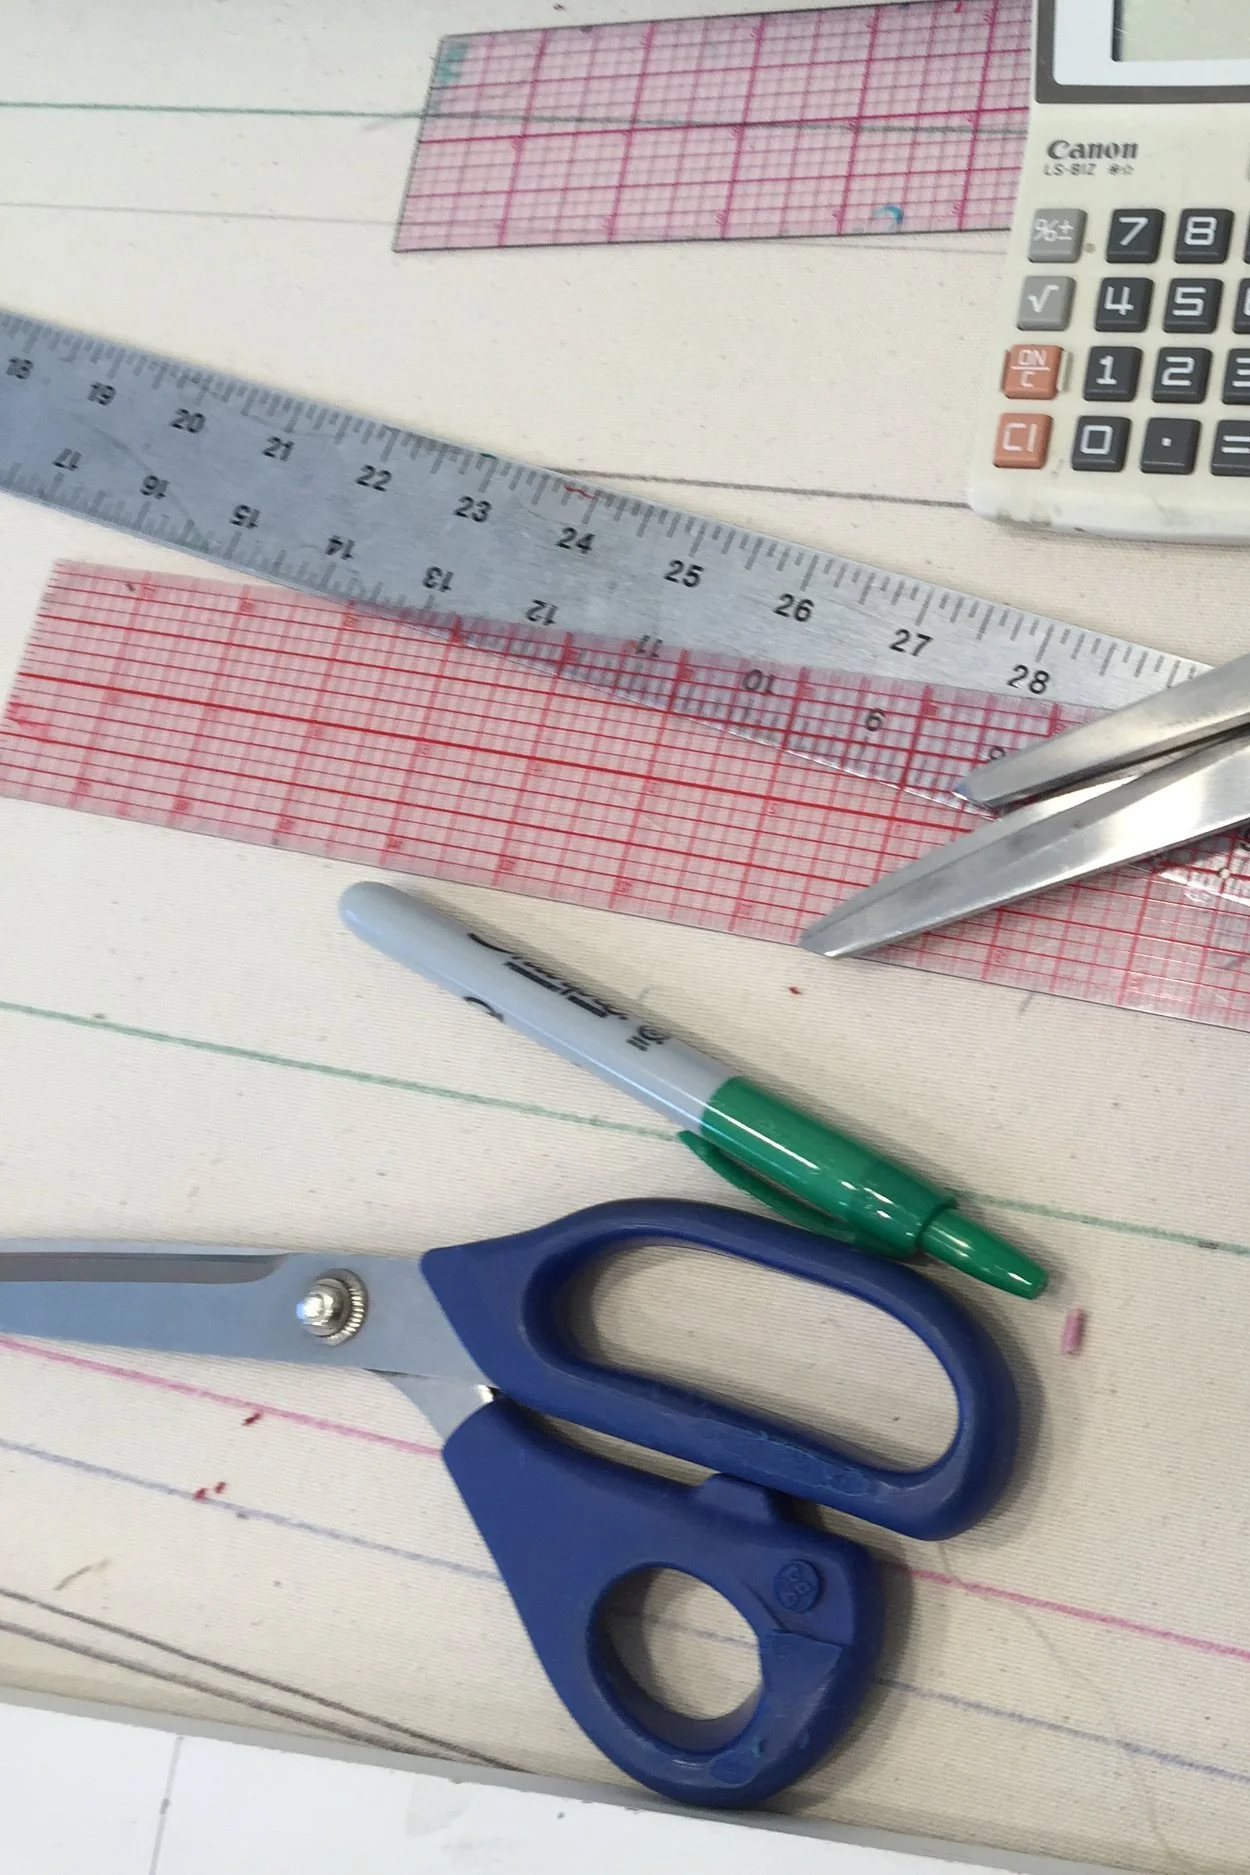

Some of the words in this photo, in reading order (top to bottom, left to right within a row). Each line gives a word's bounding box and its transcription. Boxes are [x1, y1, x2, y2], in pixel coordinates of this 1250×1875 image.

[1047, 139, 1138, 160] Canon
[1119, 216, 1149, 246] 7
[1184, 216, 1217, 246] 8
[1104, 286, 1135, 316] 4
[1172, 286, 1207, 316] 5
[1016, 350, 1047, 367] ON
[1096, 355, 1117, 385] 1
[1161, 356, 1195, 386] 2
[88, 381, 117, 406] 19
[170, 408, 206, 434] 20
[261, 436, 295, 462] 21
[1080, 425, 1113, 455] 0
[140, 475, 170, 500] 16
[355, 464, 393, 492] 22
[229, 504, 259, 530] 15
[454, 496, 492, 523] 23
[325, 536, 356, 561] 14
[555, 526, 596, 555] 24
[422, 566, 454, 593] 13
[664, 559, 705, 588] 25
[524, 600, 558, 627] 12
[772, 593, 814, 623] 26
[889, 628, 932, 658] 27
[1006, 664, 1050, 695] 28
